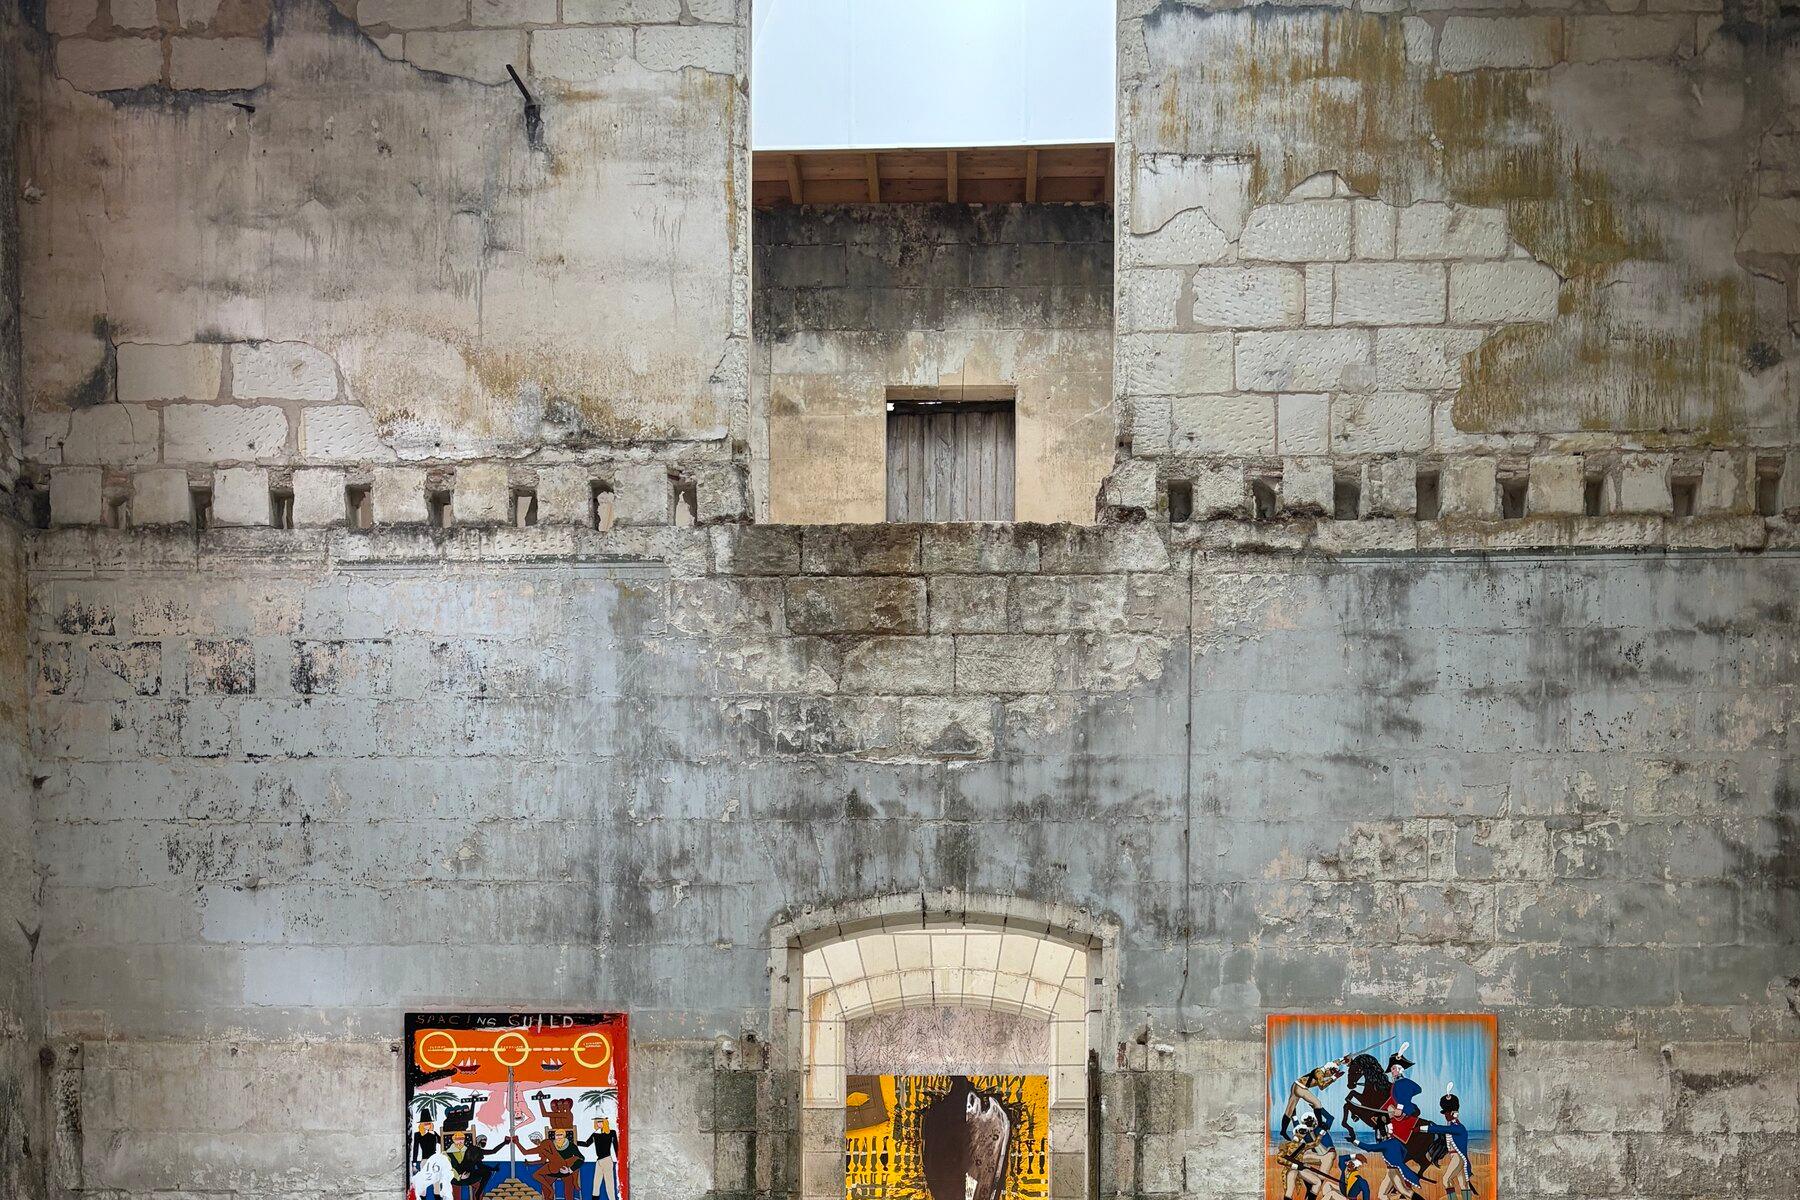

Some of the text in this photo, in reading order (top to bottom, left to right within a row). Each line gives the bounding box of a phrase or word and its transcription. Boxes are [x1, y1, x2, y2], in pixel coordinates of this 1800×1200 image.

[415, 1014, 574, 1033] SPACING GUILD
[426, 1162, 440, 1173] 16
